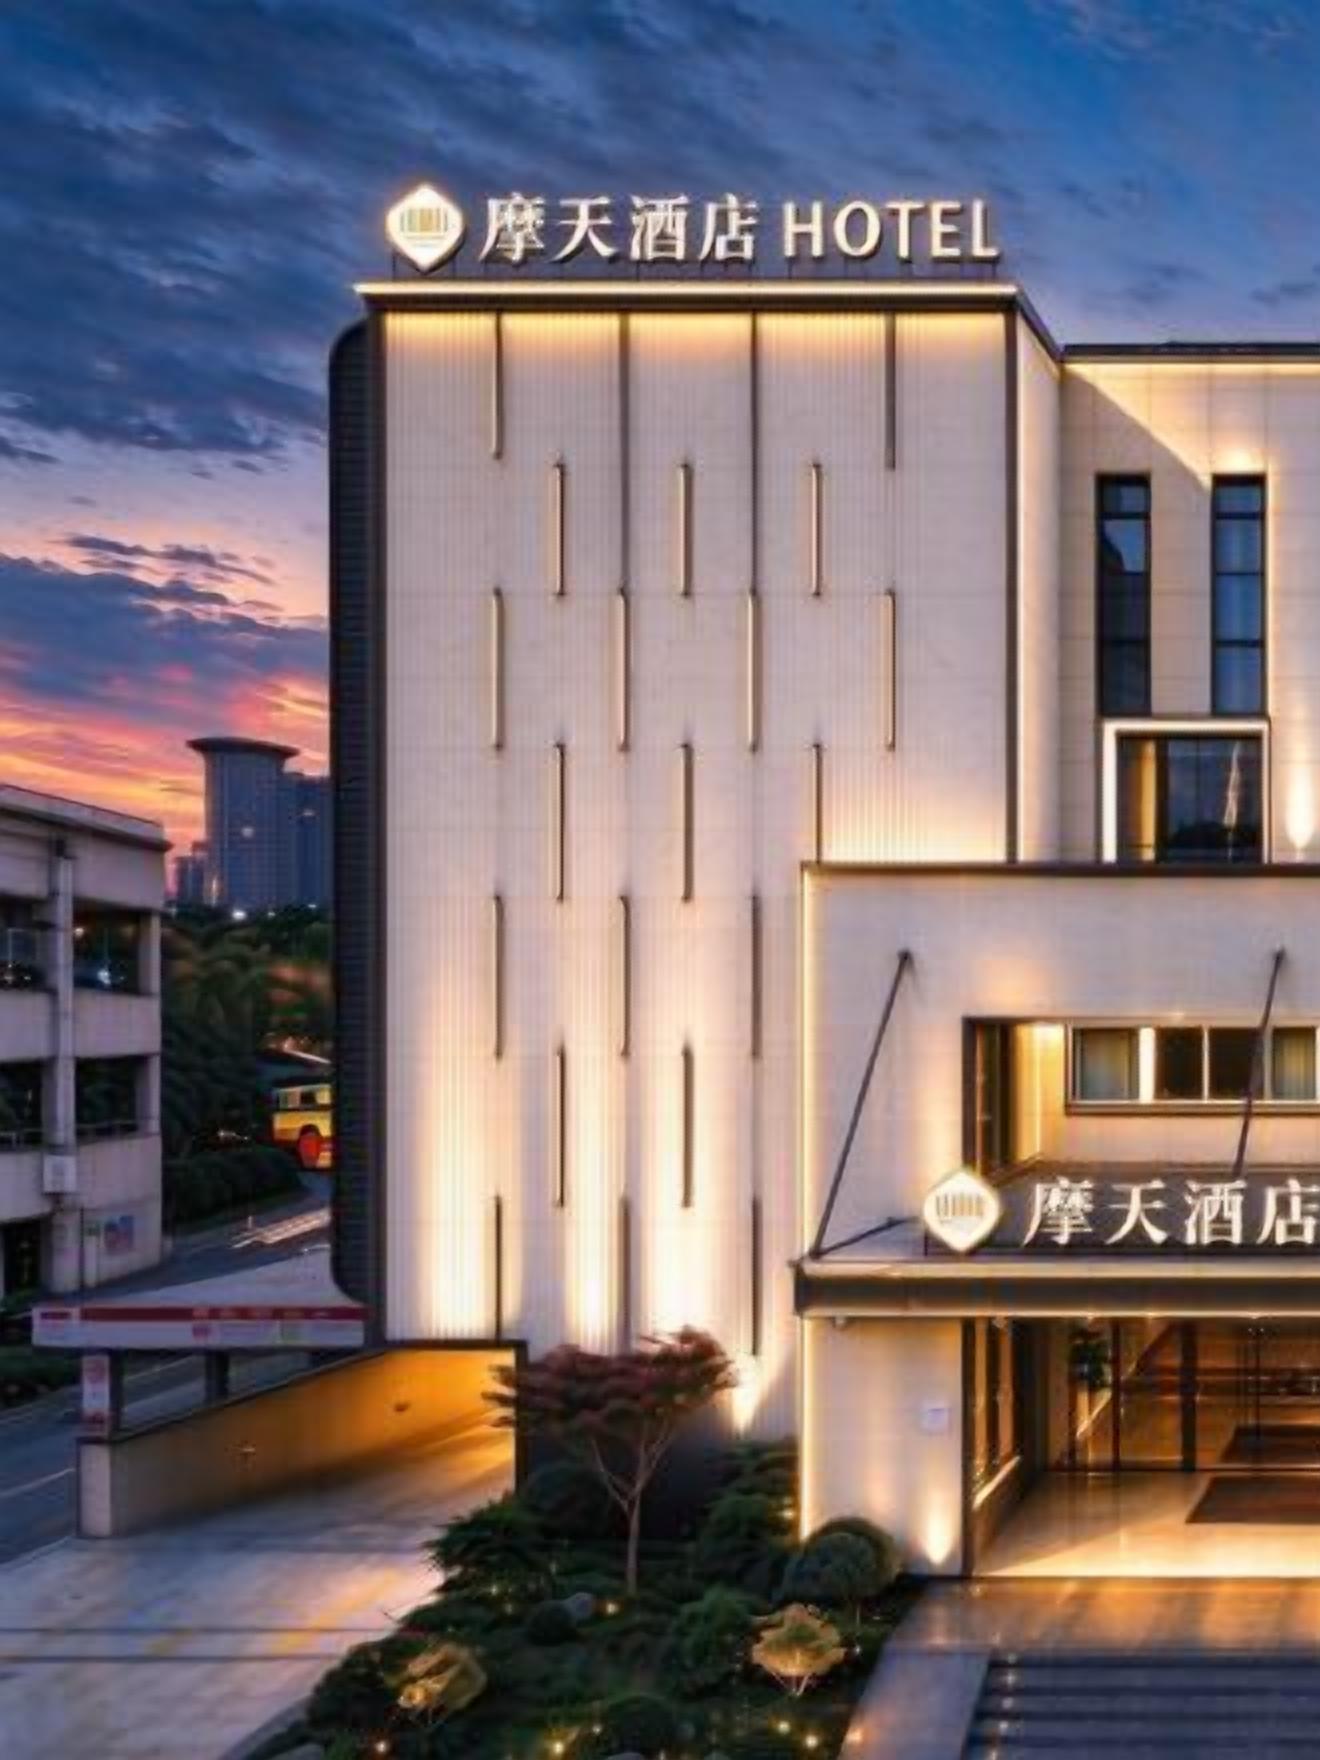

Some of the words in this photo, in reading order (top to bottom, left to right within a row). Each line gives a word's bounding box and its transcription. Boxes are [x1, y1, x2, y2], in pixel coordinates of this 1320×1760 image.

[478, 192, 759, 263] 摩天酒店
[782, 199, 1000, 259] HOTEL
[1023, 1177, 1320, 1247] 摩天酒店
